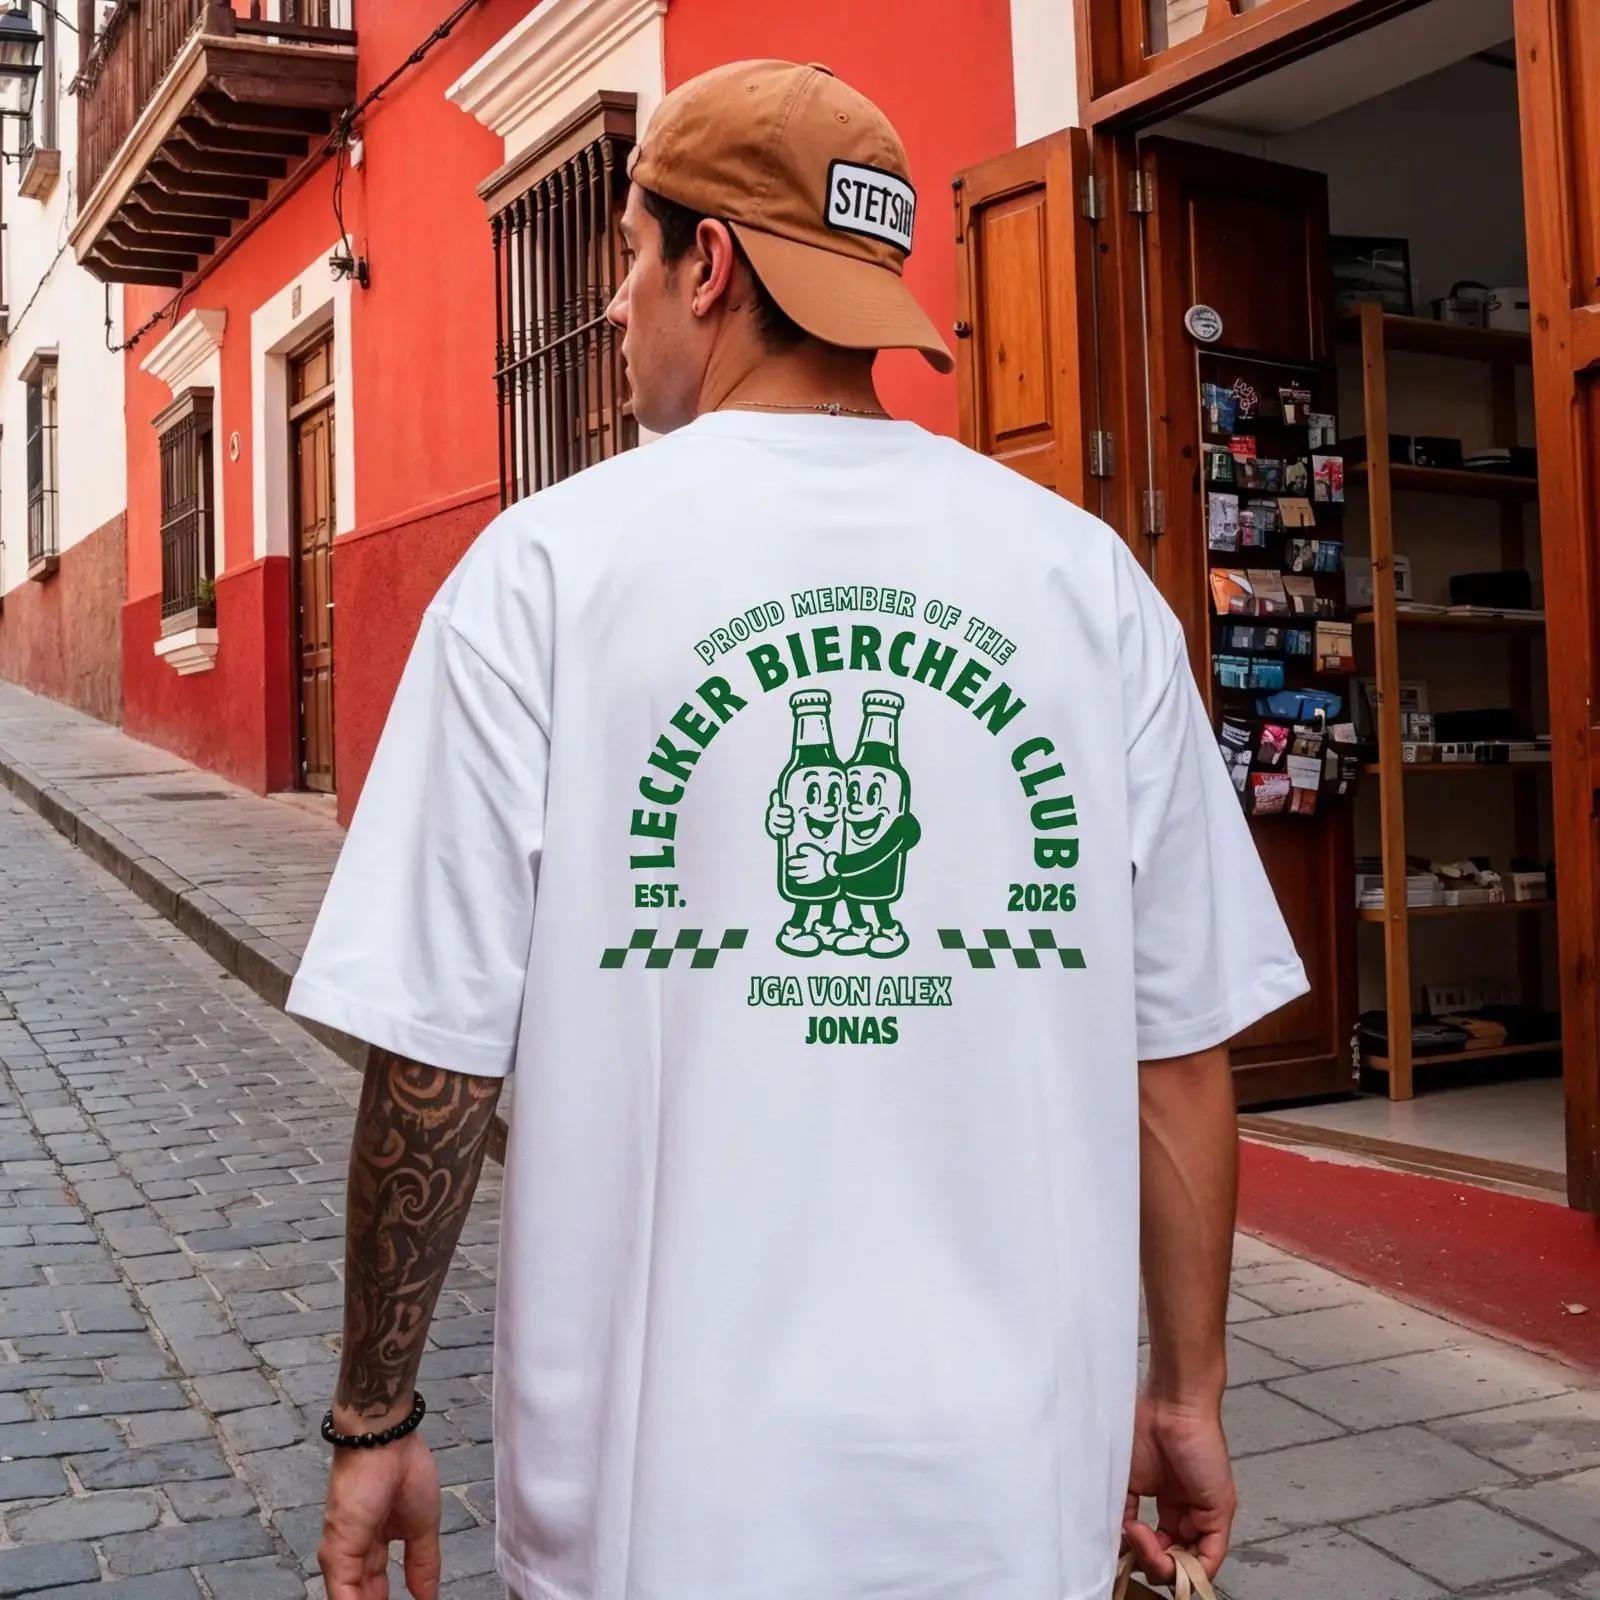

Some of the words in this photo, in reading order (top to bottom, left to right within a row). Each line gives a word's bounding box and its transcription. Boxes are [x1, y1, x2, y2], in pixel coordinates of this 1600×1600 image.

[694, 600, 785, 666] PROUD
[791, 586, 916, 619] MEMBER
[924, 600, 962, 630] OF
[963, 616, 1017, 666] THE
[630, 676, 748, 869] LECKER
[745, 625, 1027, 735] BIERCHEN
[1011, 737, 1079, 869] CLUB
[634, 884, 687, 908] EST.
[1007, 883, 1077, 912] 2026
[748, 976, 804, 1007] JGA
[807, 976, 871, 1007] VON
[875, 976, 953, 1007] ALEX
[805, 1016, 899, 1045] JONAS
